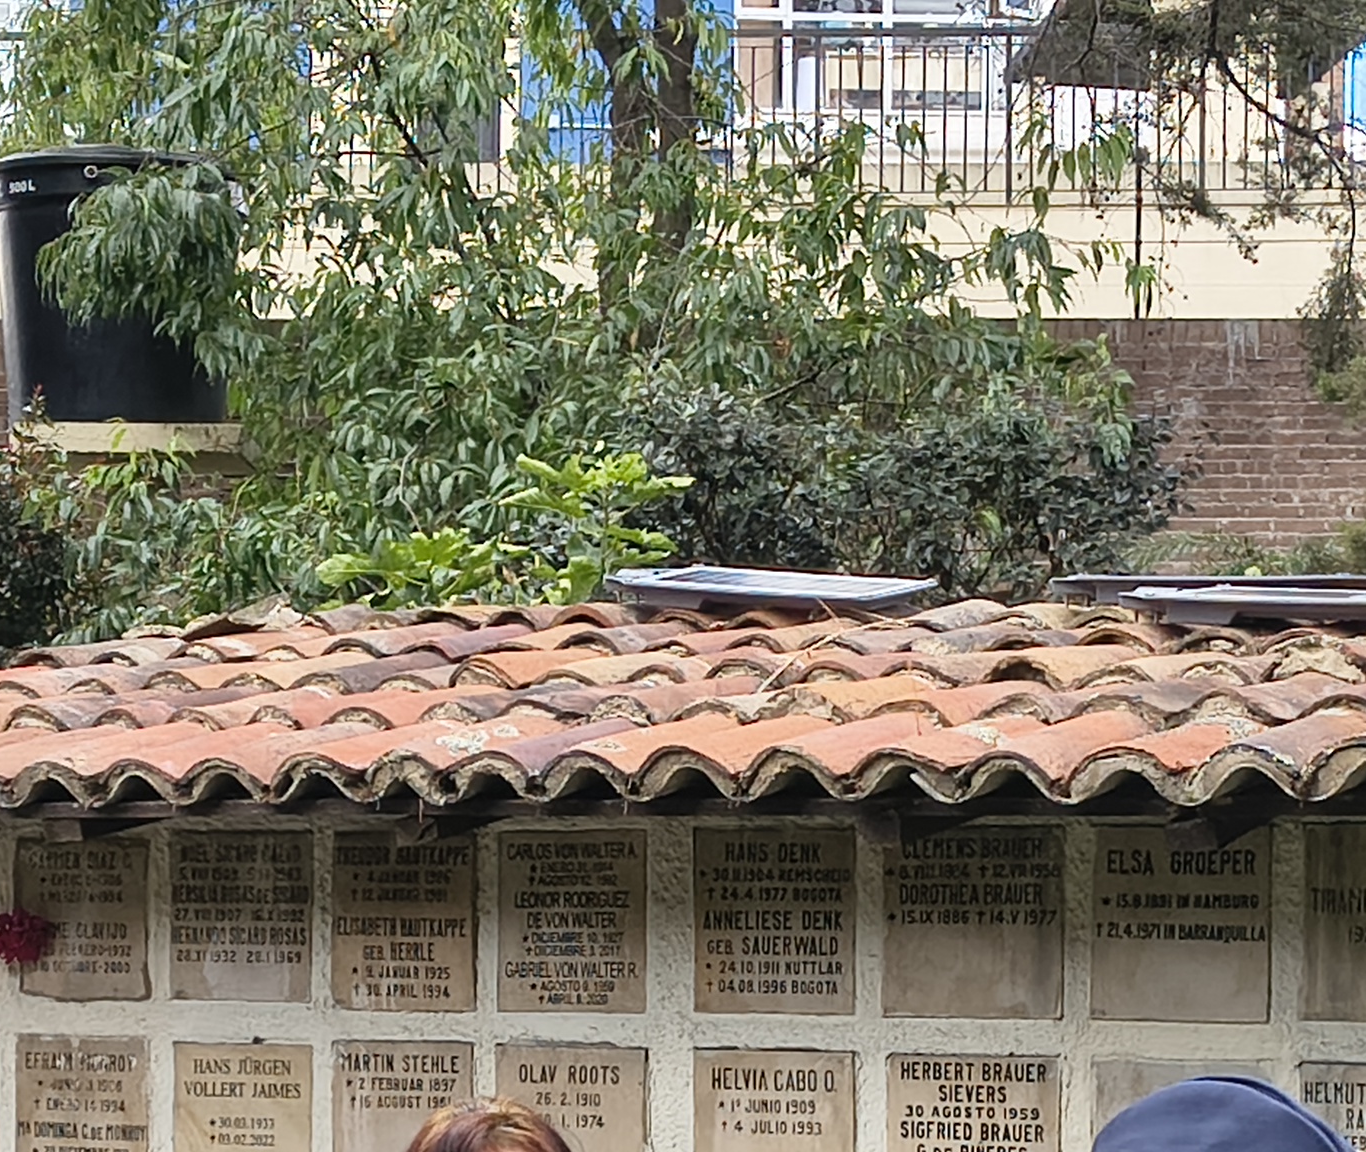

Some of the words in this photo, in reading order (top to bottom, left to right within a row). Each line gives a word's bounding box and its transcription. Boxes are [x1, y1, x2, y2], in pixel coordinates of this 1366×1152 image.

[1107, 848, 1155, 876] ELSA
[1170, 845, 1256, 876] GROEPER
[702, 905, 793, 931] ANNELIESE
[801, 909, 843, 932] DENK
[741, 935, 839, 957] SAUERWALD
[193, 1058, 231, 1075] HANS
[402, 1054, 460, 1074] STEHLE
[519, 1063, 557, 1084] OLAV
[567, 1064, 620, 1085] ROOTS
[900, 1061, 975, 1082] HERBERT
[981, 1062, 1047, 1083] BRAUER
[183, 1080, 246, 1098] VOLLERT
[938, 1084, 1007, 1104] SIEVERS
[1003, 1107, 1040, 1121] 1959
[750, 1119, 788, 1135] JULIO
[900, 1120, 973, 1141] SIGFRIED
[980, 1122, 1044, 1143] BRAUER
